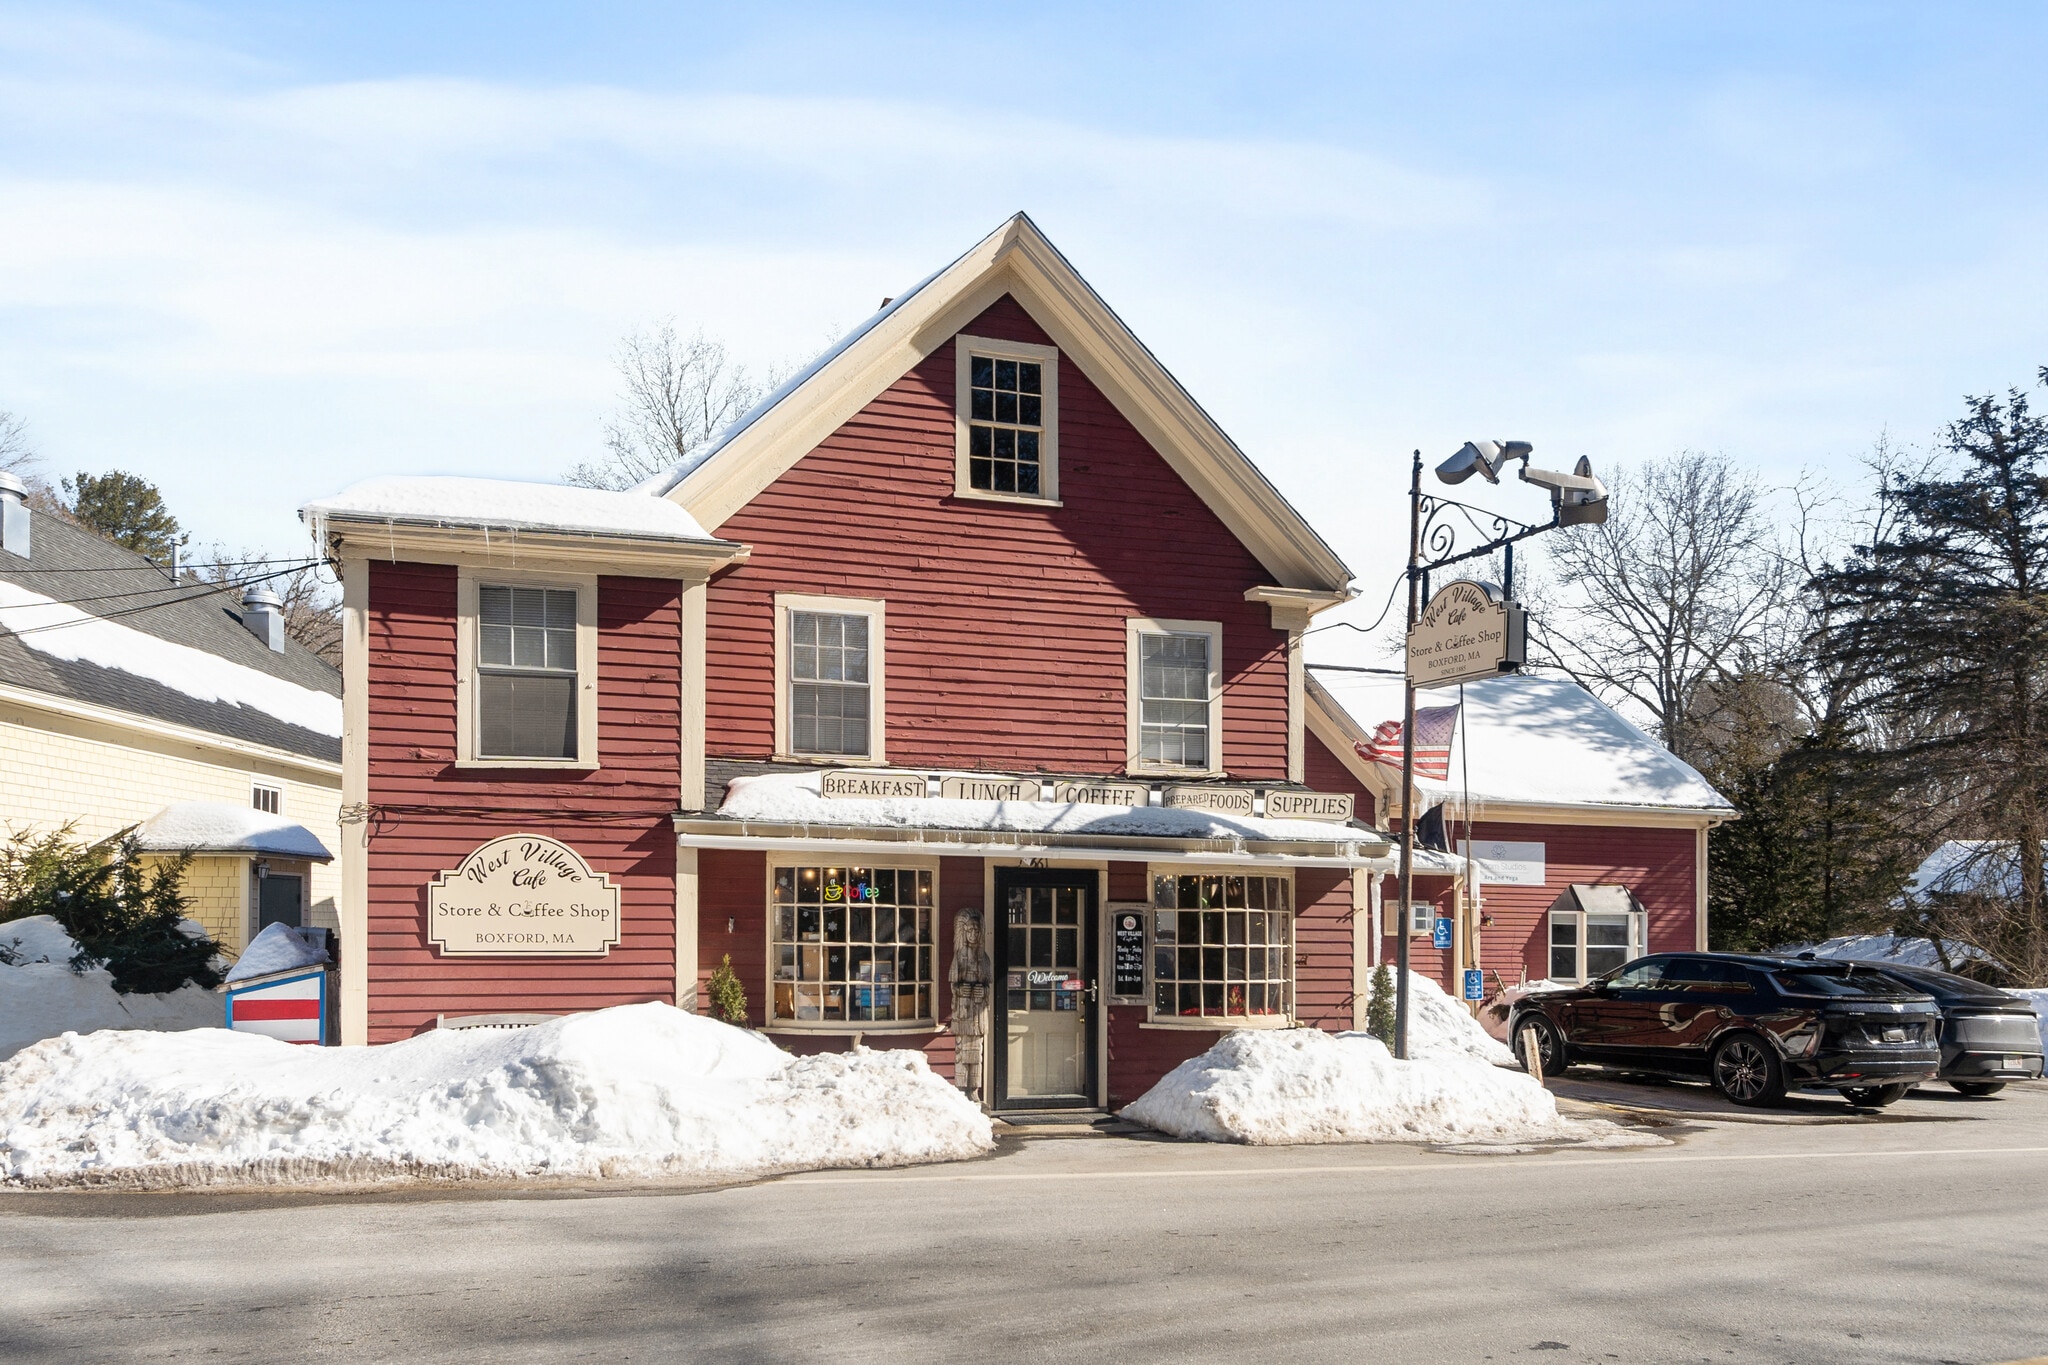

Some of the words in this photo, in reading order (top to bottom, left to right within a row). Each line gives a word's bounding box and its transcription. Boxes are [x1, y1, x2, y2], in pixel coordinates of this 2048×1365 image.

[1425, 597, 1448, 628] West
[1452, 586, 1486, 614] Village
[1448, 607, 1467, 626] Cafe
[1410, 646, 1432, 658] Store
[1435, 641, 1443, 652] &
[1478, 629, 1501, 643] Shop
[1428, 653, 1466, 669] BOXFORD,
[1468, 650, 1481, 661] MA
[825, 778, 923, 798] BREAKFAST
[959, 782, 1021, 801] LUNCH
[1066, 787, 1135, 807] COFFEE
[1165, 792, 1209, 807] PREPARED
[1209, 793, 1250, 810] FOODS
[1272, 796, 1347, 815] SUPPLIES
[467, 848, 511, 884] West
[520, 842, 582, 884] Village
[512, 868, 547, 890] Cafe
[843, 882, 880, 900] Coffee
[438, 902, 482, 918] Store
[487, 902, 502, 917] &
[570, 902, 610, 921] Shop
[475, 932, 549, 945] BOXFORD,
[552, 932, 575, 944] MA
[1027, 969, 1069, 985] Welcome
